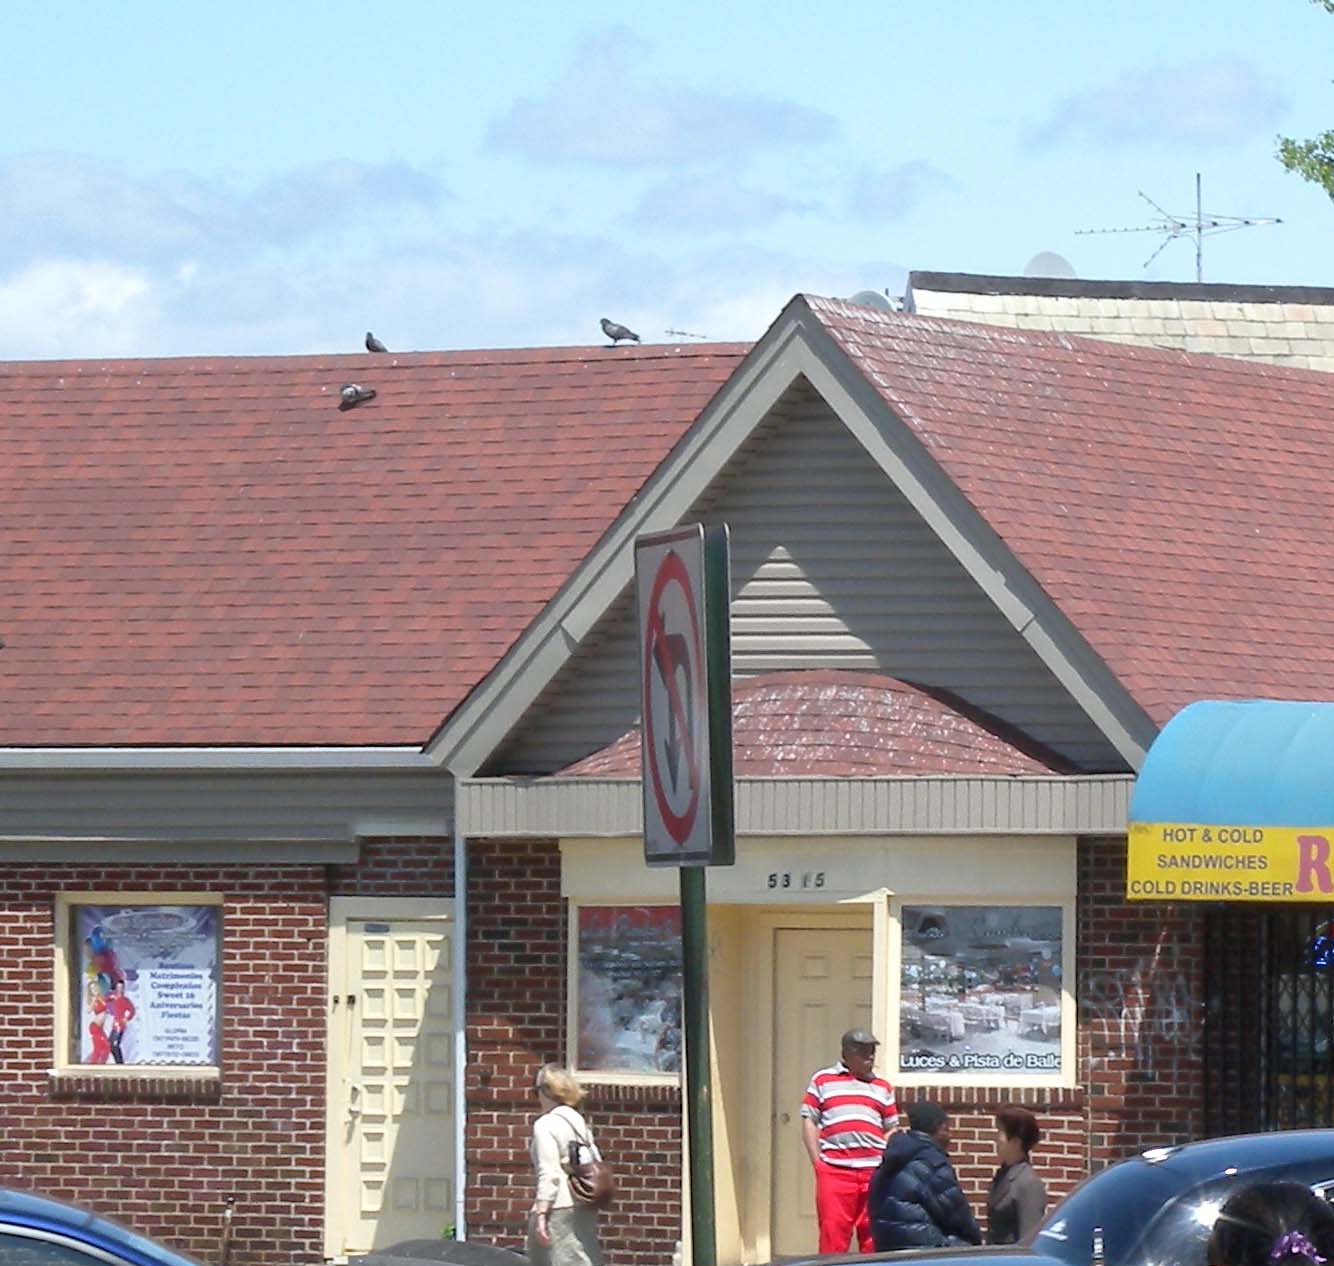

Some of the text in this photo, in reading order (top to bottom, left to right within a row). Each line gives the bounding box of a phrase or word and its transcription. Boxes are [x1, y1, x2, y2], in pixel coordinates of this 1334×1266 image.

[1163, 828, 1196, 843] HOT
[1202, 829, 1213, 843] &
[1217, 829, 1264, 844] COLD
[1157, 854, 1269, 870] SANDWICHES
[1130, 880, 1293, 897] COLD DRINKS-BEER
[900, 1054, 945, 1068] Luces
[949, 1055, 961, 1068] &
[964, 1053, 1000, 1068] Pista
[1003, 1053, 1023, 1068] de
